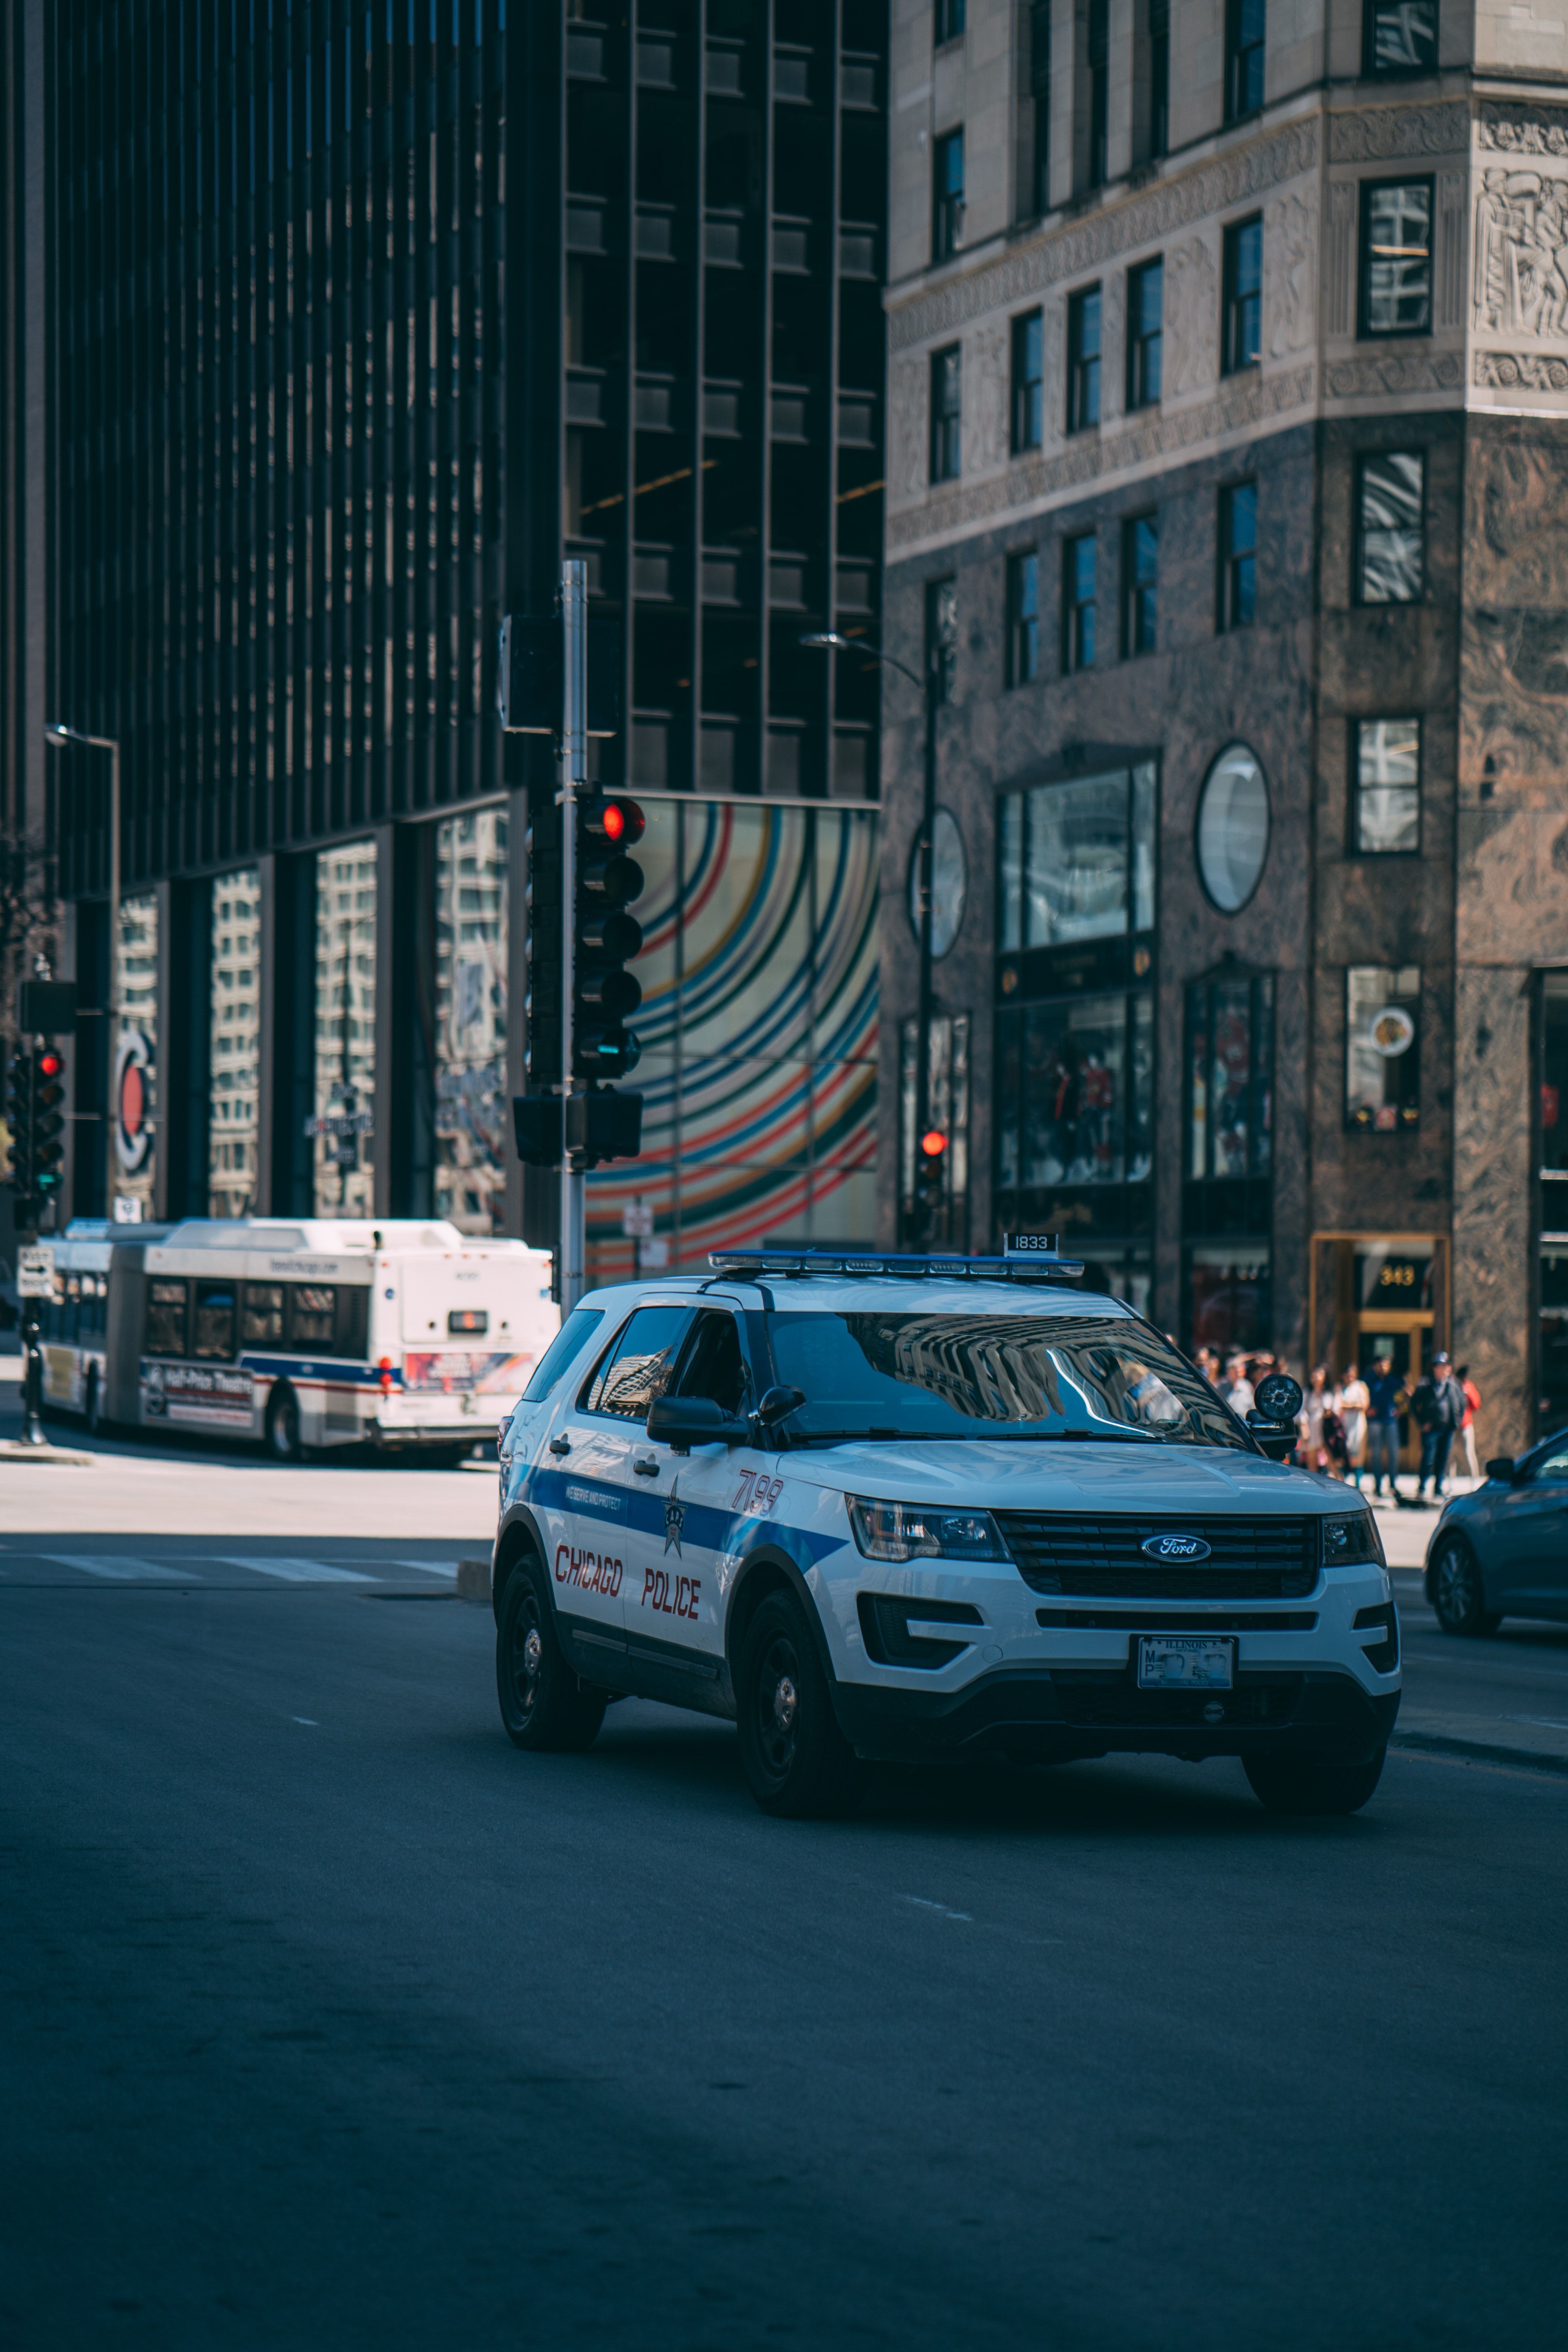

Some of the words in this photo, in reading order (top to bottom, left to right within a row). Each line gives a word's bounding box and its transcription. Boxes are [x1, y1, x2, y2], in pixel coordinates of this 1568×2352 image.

[1016, 1236, 1047, 1249] 1833
[566, 1486, 574, 1499] WE
[573, 1487, 589, 1503] SERVE
[589, 1491, 599, 1506] AND
[599, 1494, 621, 1511] PROTECT
[732, 1469, 783, 1516] 7199
[666, 1510, 683, 1528] CAPS
[1160, 1538, 1197, 1554] Ford
[555, 1545, 622, 1597] CHICAGO
[641, 1568, 701, 1620] POLICE
[1165, 1641, 1207, 1649] ILLINOIS
